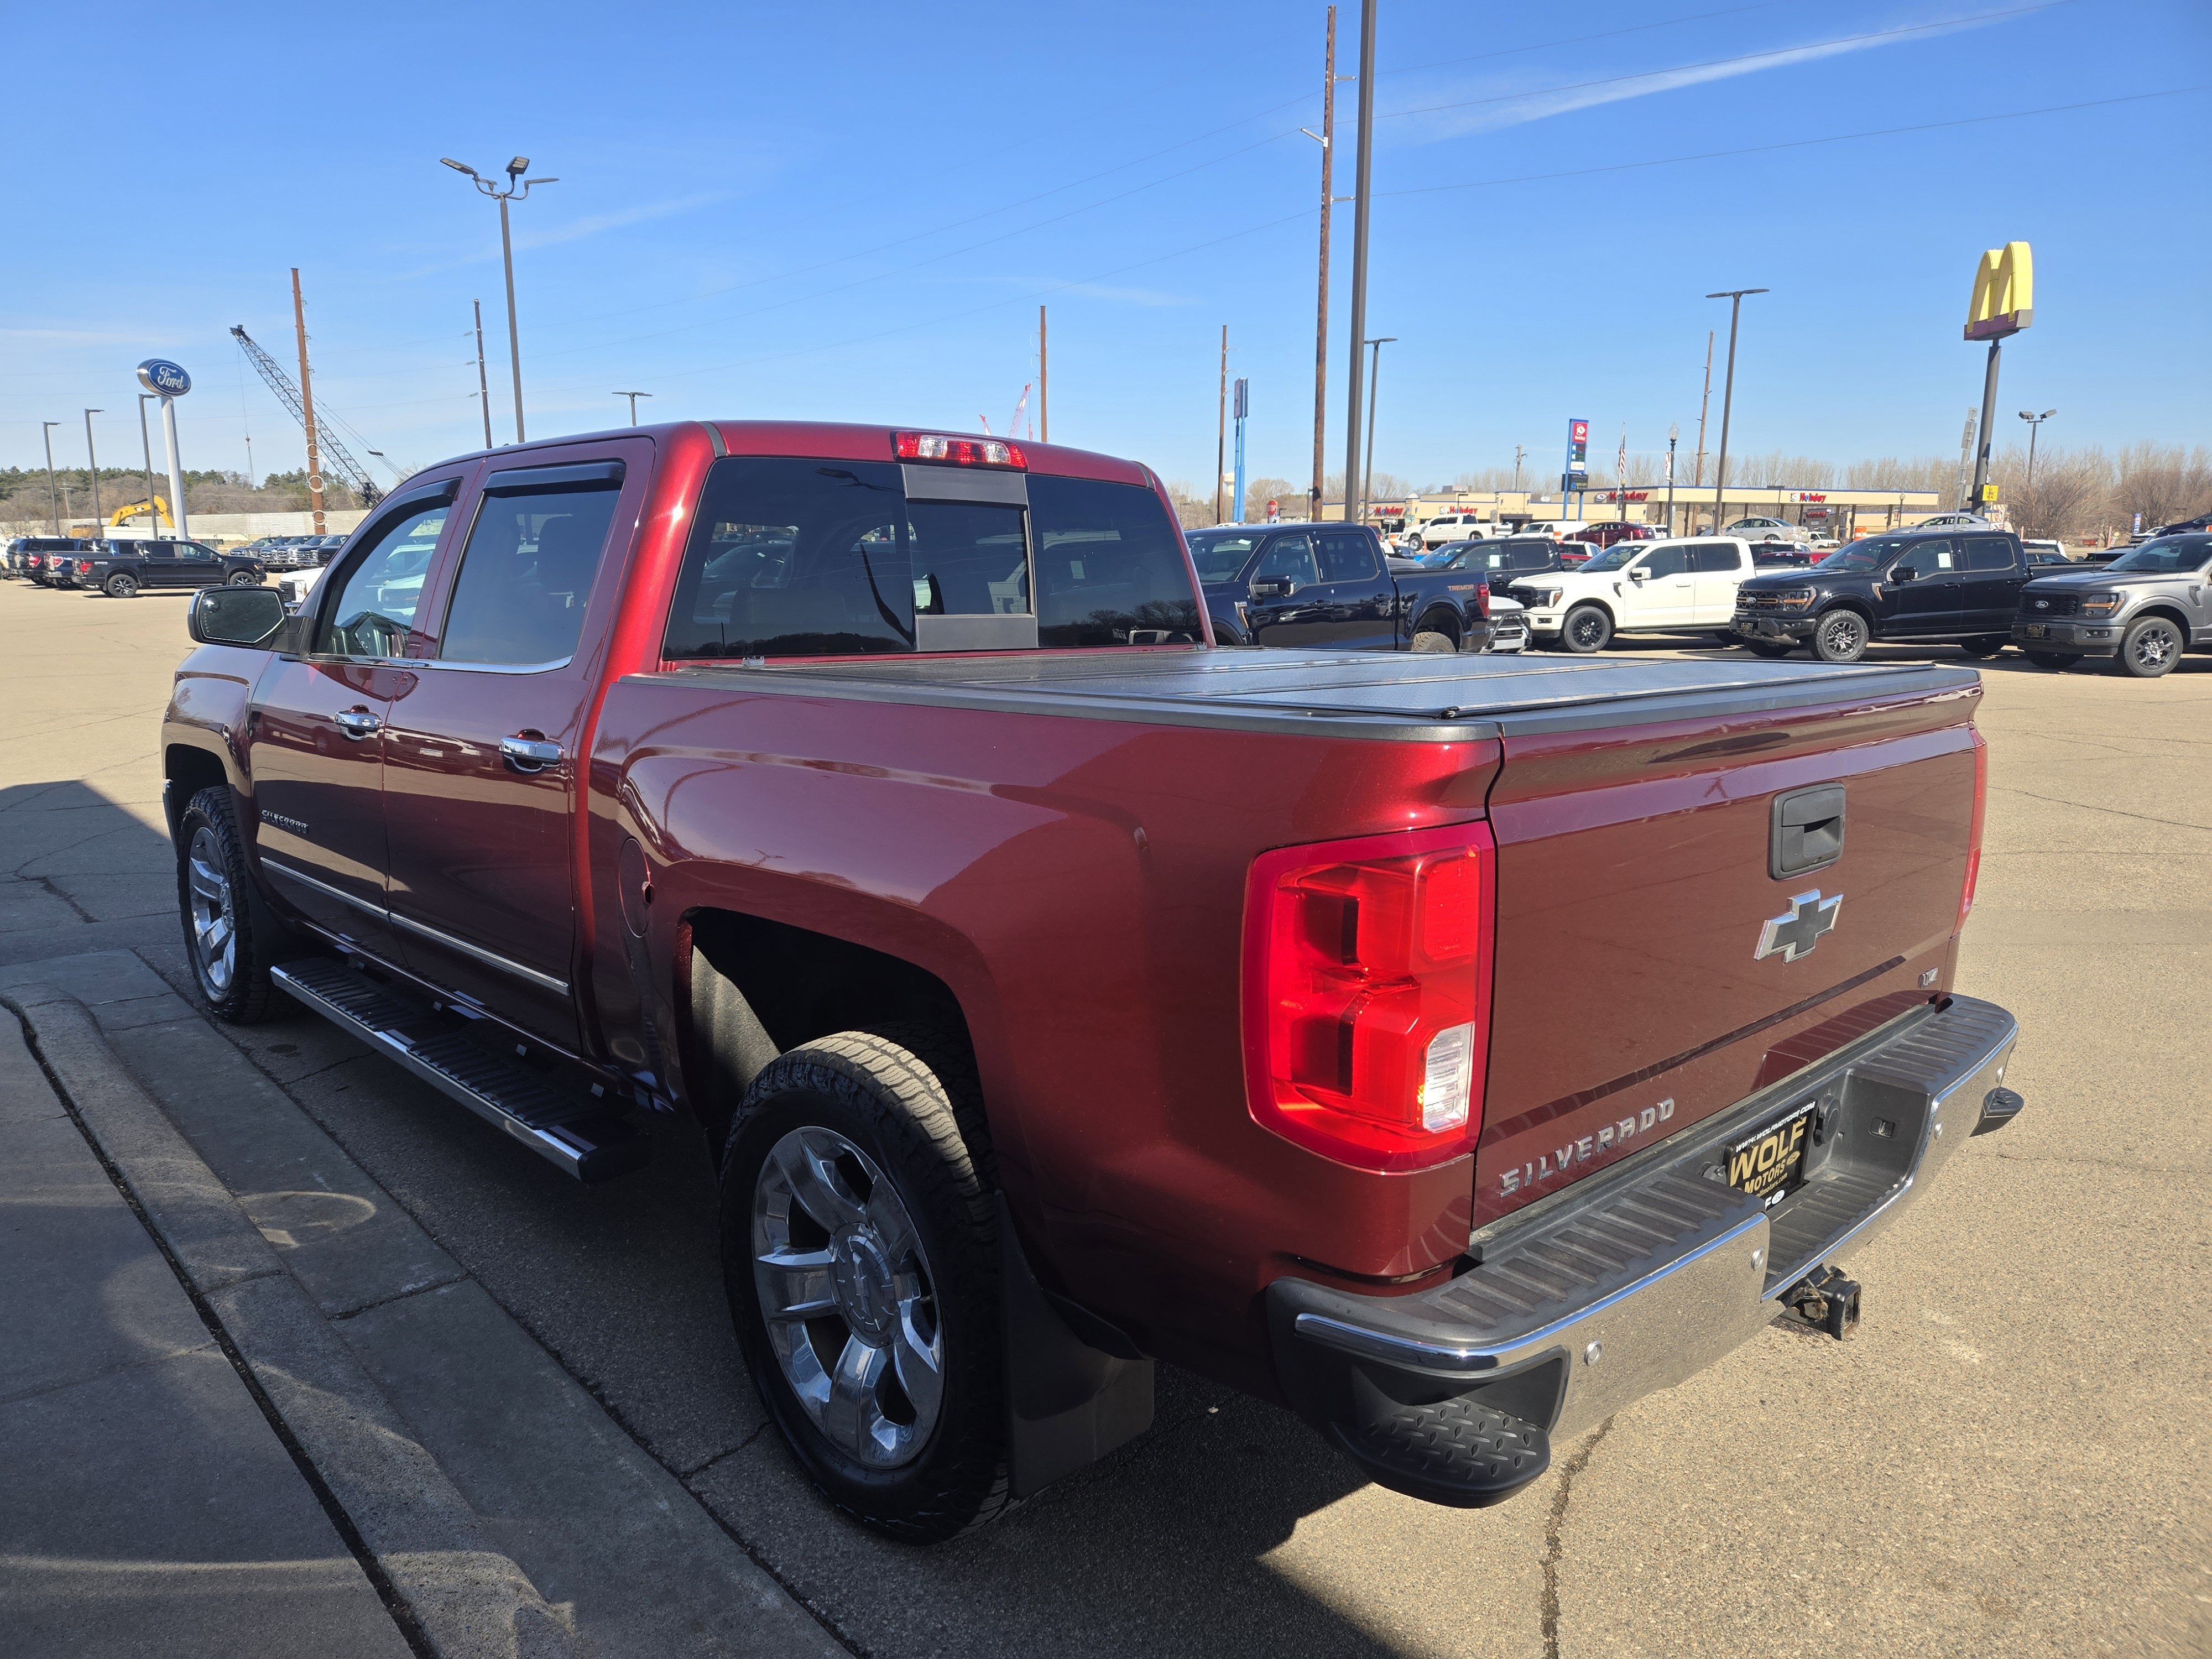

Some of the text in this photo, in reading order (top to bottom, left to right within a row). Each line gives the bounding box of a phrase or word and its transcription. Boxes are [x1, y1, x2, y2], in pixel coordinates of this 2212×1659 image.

[158, 366, 184, 389] Ford
[1496, 1097, 1675, 1198] SILVERADO
[1730, 1116, 1807, 1187] WOLF
[1744, 1159, 1786, 1194] MOTORS
